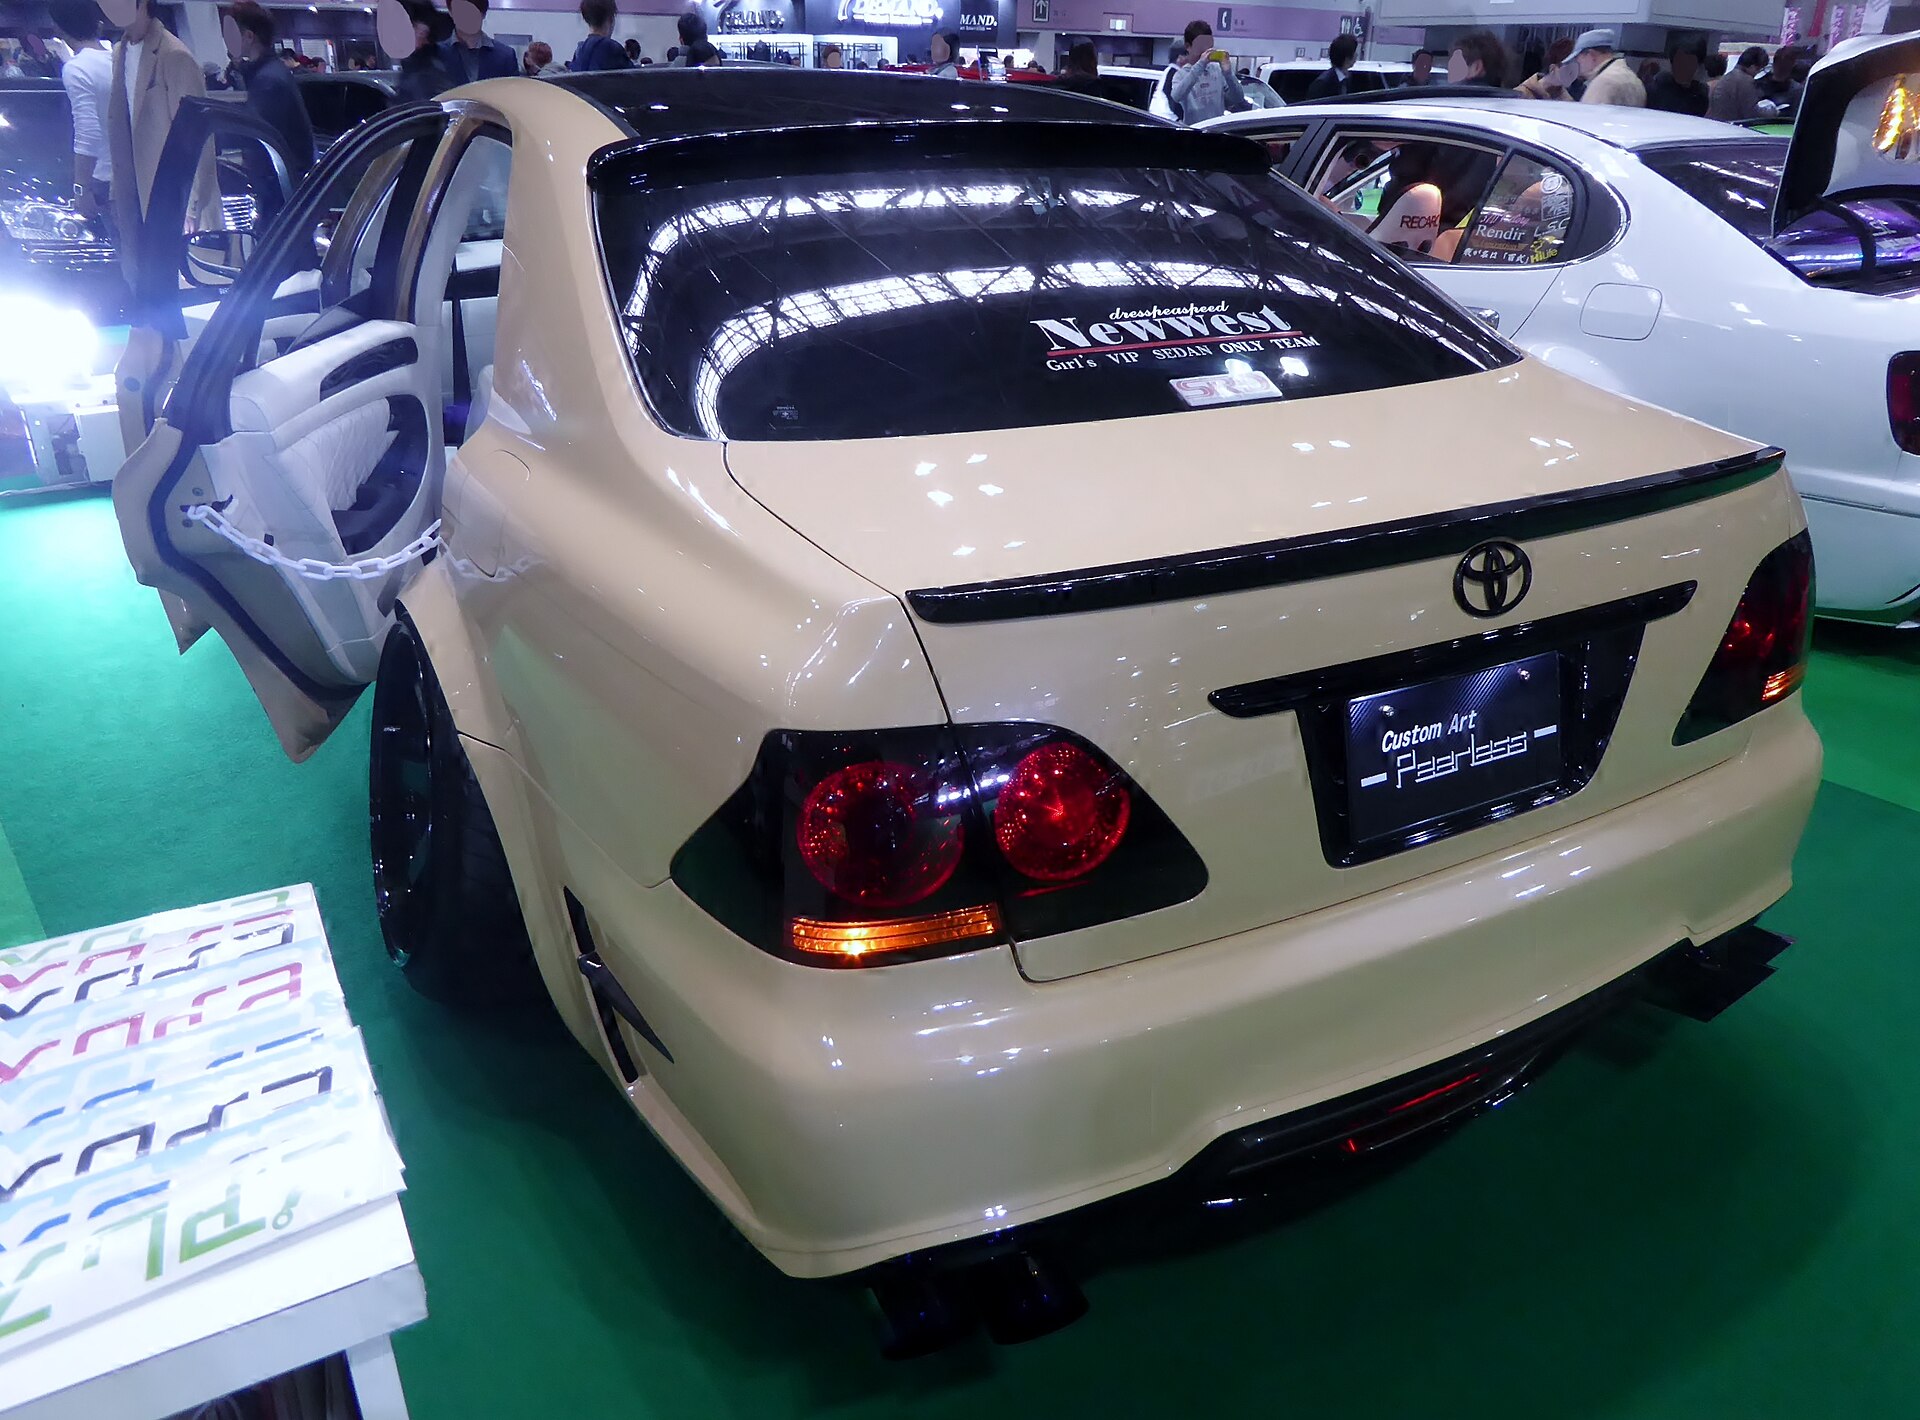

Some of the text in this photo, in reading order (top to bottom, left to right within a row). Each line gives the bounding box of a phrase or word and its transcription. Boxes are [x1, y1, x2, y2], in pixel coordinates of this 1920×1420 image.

[1475, 224, 1526, 241] Rendir
[1030, 305, 1292, 350] Newwest
[1046, 335, 1320, 372] Girl's VIP SEDAN ONLY TEAM
[1382, 709, 1478, 753] Custom Art
